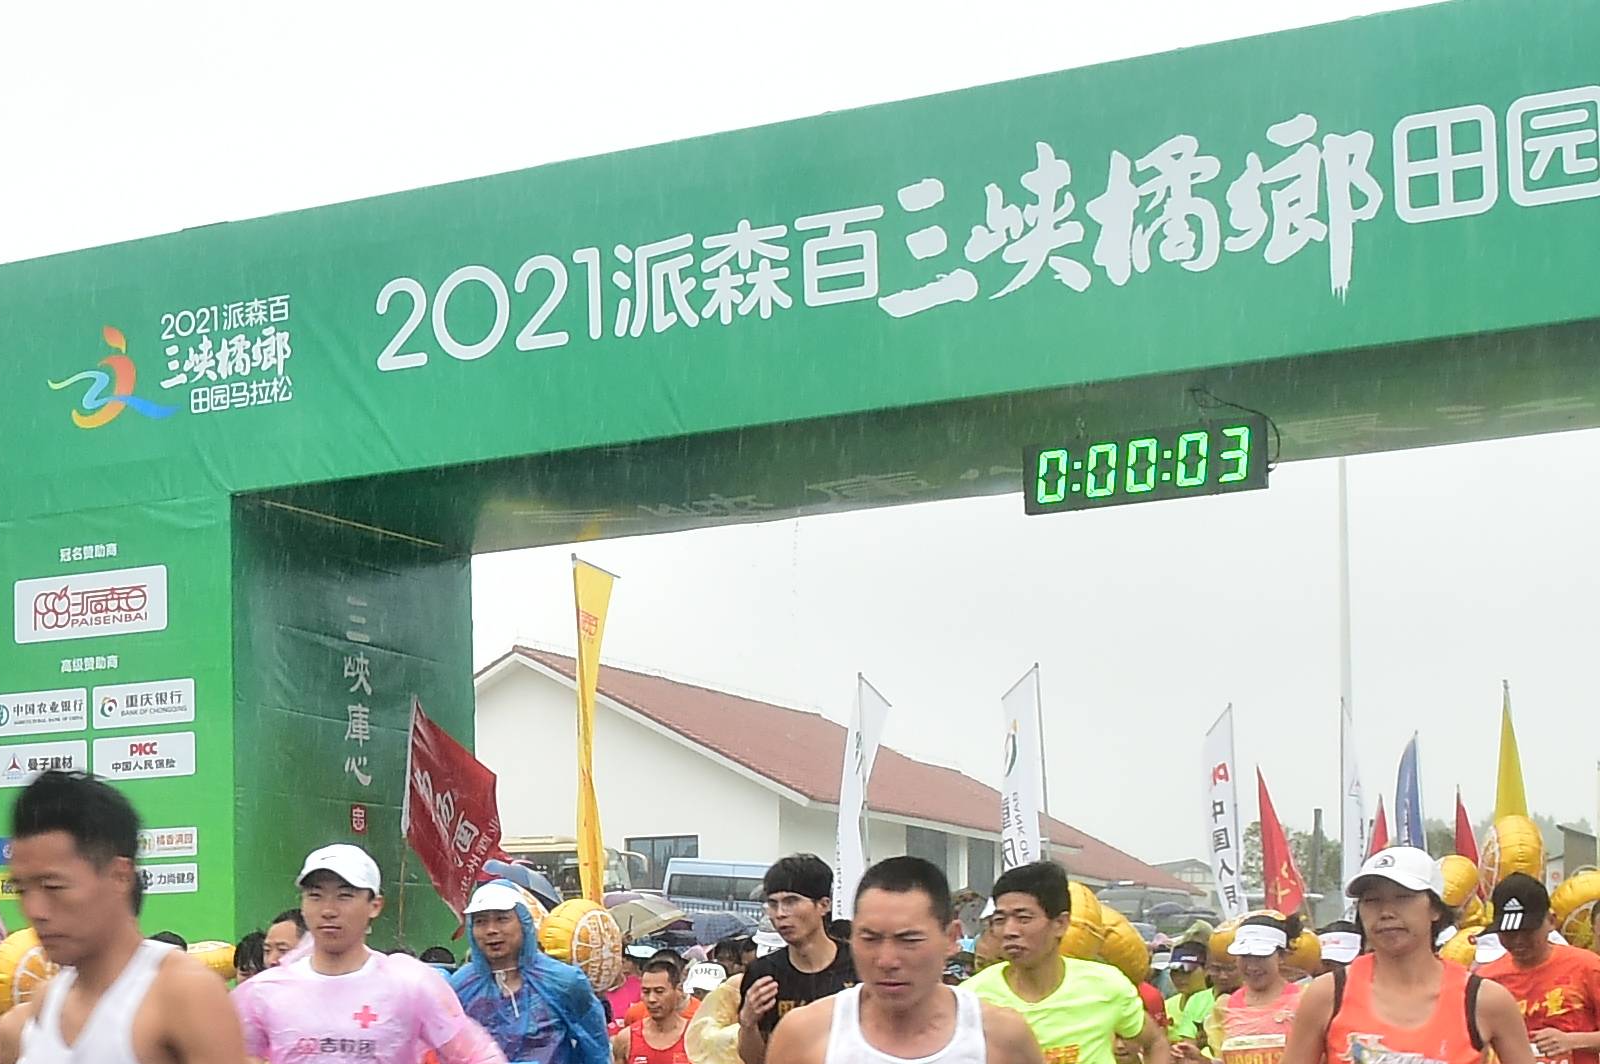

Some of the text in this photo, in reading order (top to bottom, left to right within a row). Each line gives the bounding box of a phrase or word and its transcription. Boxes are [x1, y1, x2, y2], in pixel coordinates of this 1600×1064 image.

[160, 294, 290, 340] 2021派森百
[190, 375, 293, 414] 田园马拉松
[1036, 424, 1251, 505] 0:00:03
[59, 543, 118, 562] 冠名赞助商
[71, 611, 148, 628] PAISENBAI
[60, 655, 118, 674] 高级赞助商
[12, 699, 84, 717] 中国农业银行
[125, 690, 183, 708] 重庆银行
[129, 741, 158, 757] PICC
[111, 758, 176, 773] 中国人民保险
